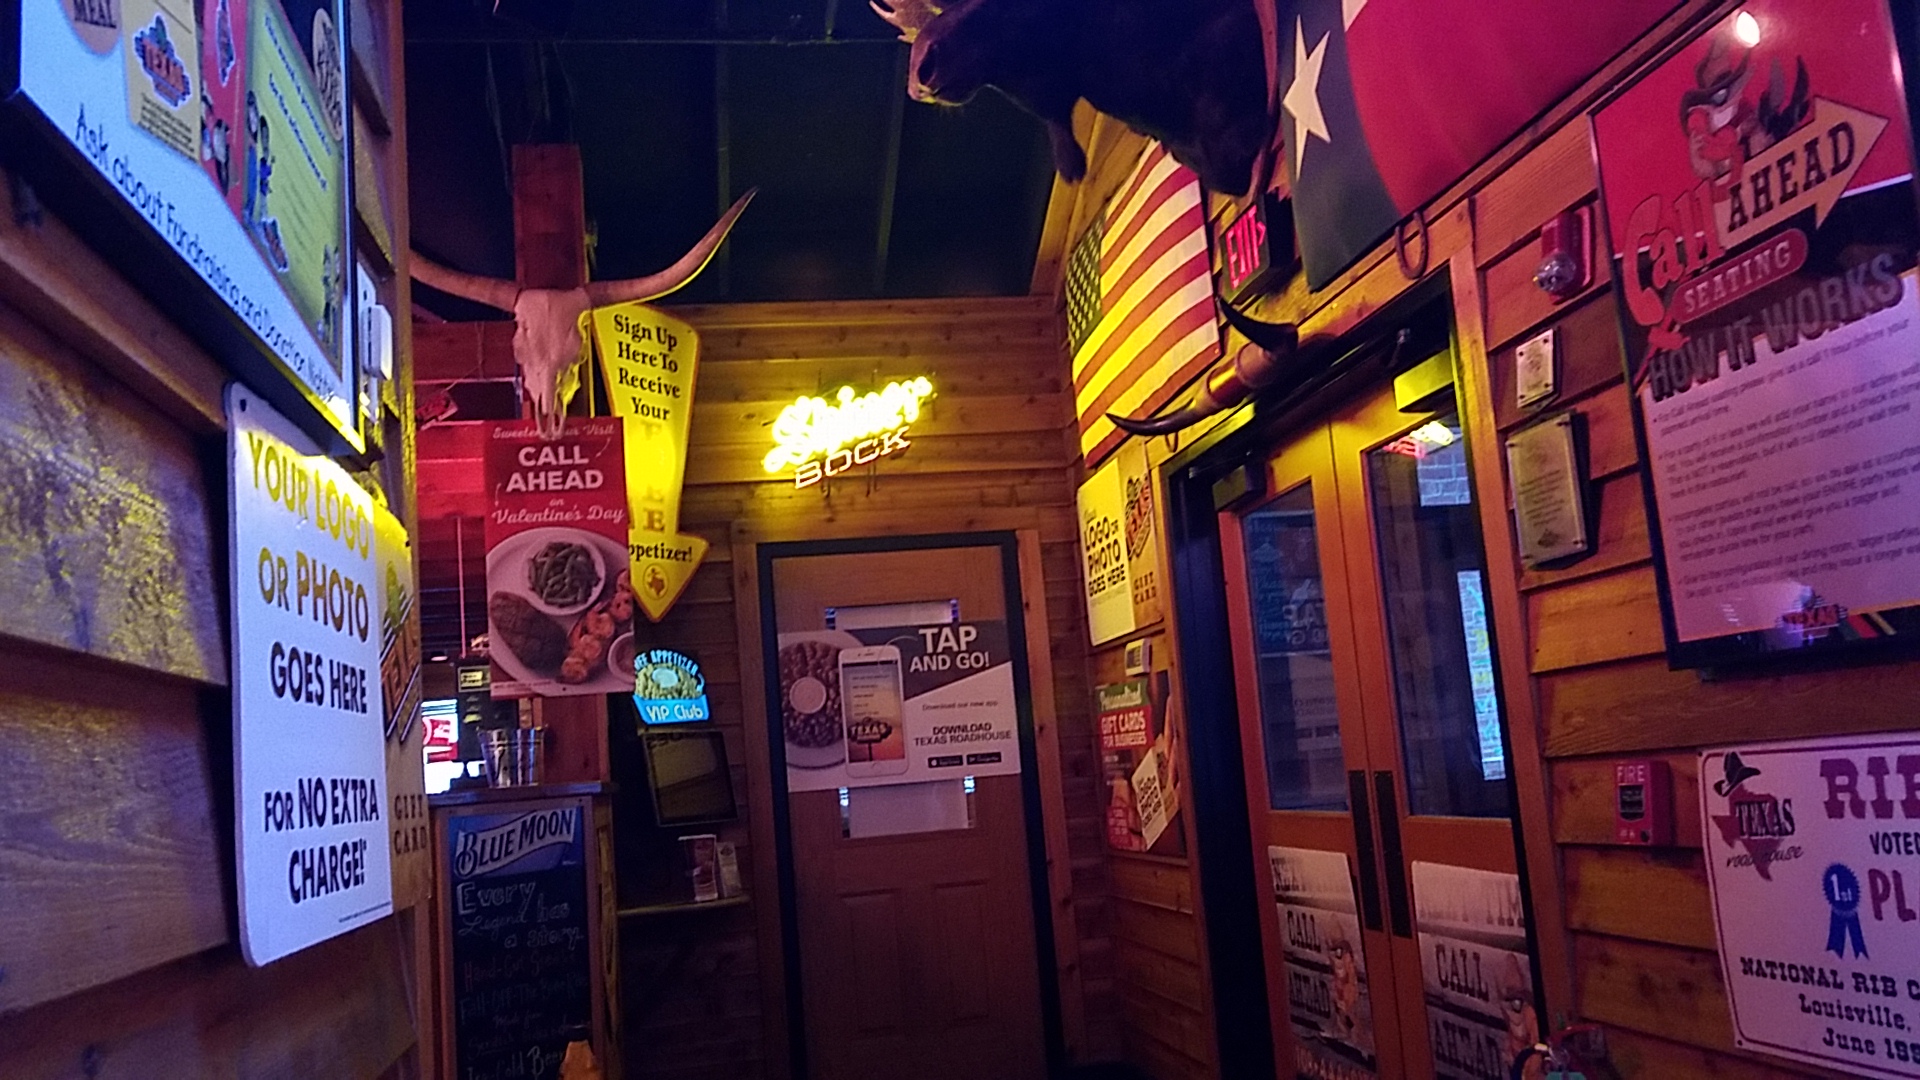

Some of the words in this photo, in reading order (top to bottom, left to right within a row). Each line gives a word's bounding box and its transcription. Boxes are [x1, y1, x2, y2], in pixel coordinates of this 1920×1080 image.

[76, 101, 110, 171] Ask
[112, 154, 164, 227] about
[1728, 120, 1856, 234] AHEAD
[1225, 204, 1260, 291] EXIT
[1622, 176, 1726, 326] Call
[1683, 239, 1792, 314] SEATING
[613, 313, 653, 343] Sign
[653, 325, 678, 351] Up
[1649, 332, 1720, 402] HOW
[1724, 314, 1758, 371] IT
[1761, 252, 1905, 354] WORKS
[617, 341, 658, 367] Here
[658, 350, 679, 374] To
[617, 367, 682, 399] Receive
[631, 396, 671, 422] Your
[518, 445, 590, 467] CALL
[794, 425, 912, 489] BOCK
[248, 431, 309, 520] YOUR
[314, 468, 370, 561] LOGO
[505, 469, 604, 493] AHEAD
[491, 504, 583, 524] Valentine's
[586, 505, 624, 524] Day
[629, 541, 693, 563] ppetizer!
[1084, 516, 1111, 552] LOGO
[1087, 538, 1121, 578] PHOTO
[258, 546, 290, 612] OR
[296, 550, 369, 643] PHOTO
[918, 625, 978, 654] TAP
[270, 641, 325, 707] GOES
[329, 658, 368, 715] HERE
[910, 654, 952, 673] AND
[955, 651, 990, 670] GO!
[645, 704, 670, 722] VIP
[674, 703, 704, 720] Club
[932, 722, 993, 736] DOWNLOAD
[1101, 714, 1118, 736] GIFT
[1118, 709, 1146, 734] CARDS
[914, 735, 948, 748] TEXAS
[949, 730, 1012, 744] ROADHOUSE
[1616, 765, 1645, 783] FIRE
[264, 789, 295, 833] FOR
[298, 776, 327, 829] NO
[330, 777, 380, 826] EXTRA
[1734, 798, 1796, 836] TEXAS
[394, 825, 428, 855] CARD
[456, 828, 516, 877] BLUE
[518, 809, 574, 851] MOON
[456, 880, 537, 923] Every
[1286, 910, 1322, 954] CALL
[1435, 943, 1490, 1003] CALL
[1740, 956, 1845, 990] NATIONAL
[1852, 971, 1898, 998] RIB
[1822, 1027, 1876, 1056] June
